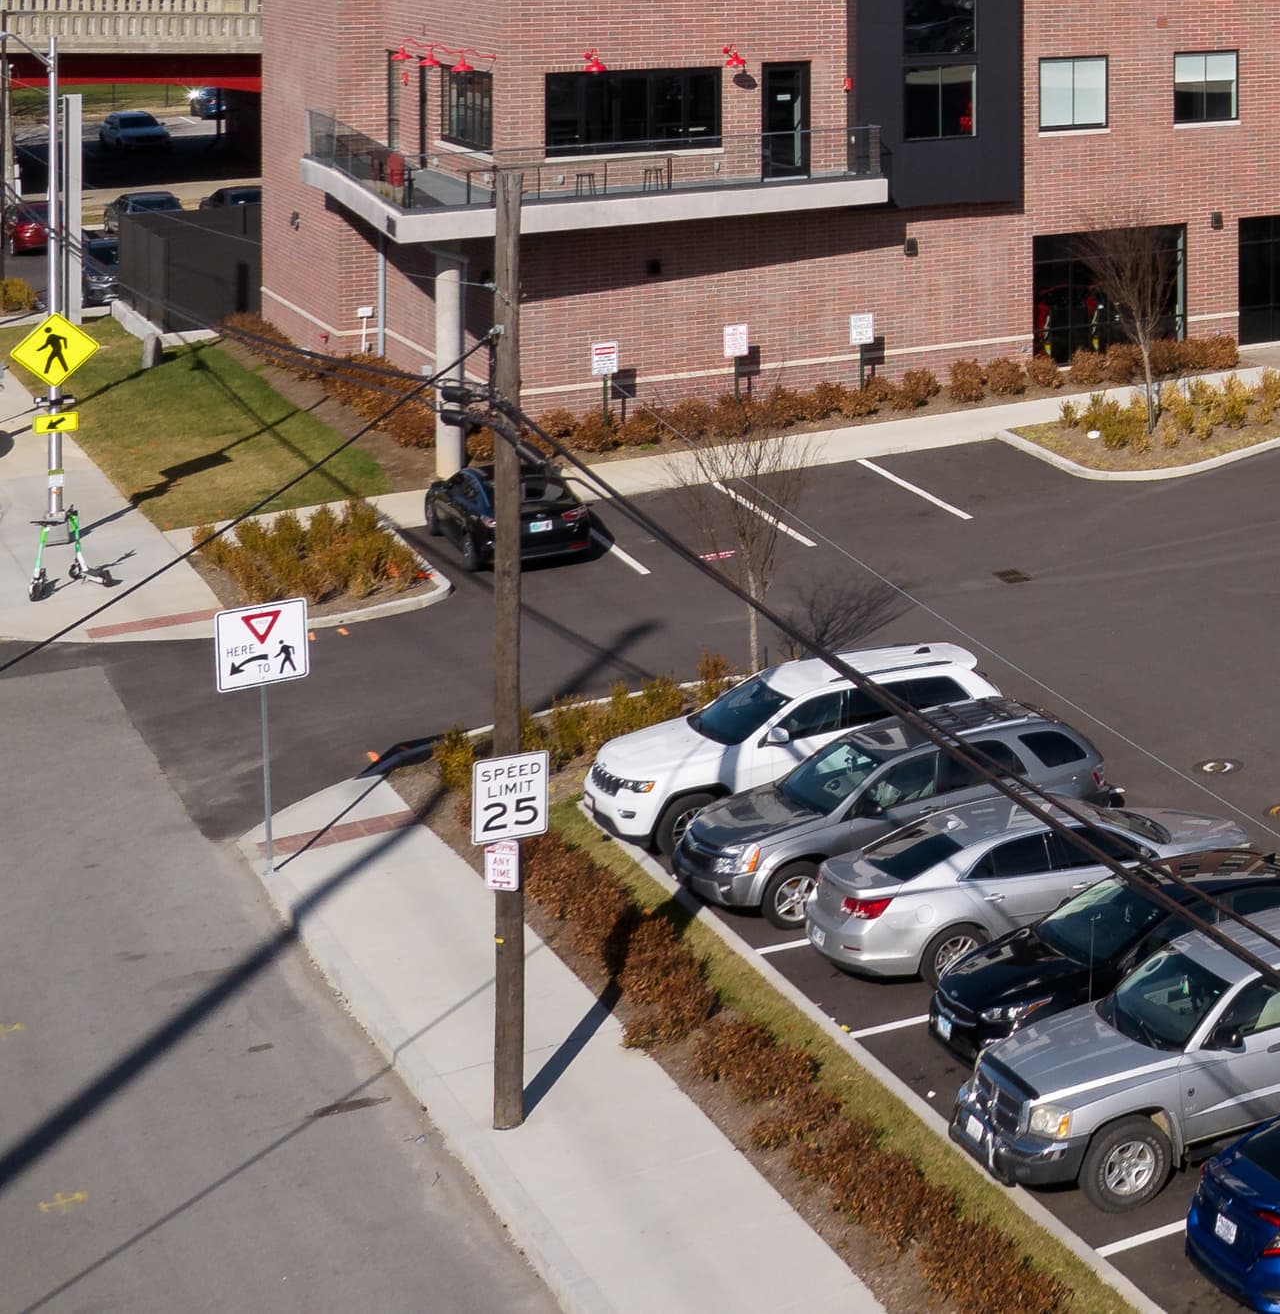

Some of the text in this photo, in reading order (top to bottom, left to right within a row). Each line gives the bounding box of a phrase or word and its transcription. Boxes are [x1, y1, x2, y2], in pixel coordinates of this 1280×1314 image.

[226, 643, 256, 658] HERE
[257, 663, 270, 674] TO
[481, 762, 541, 782] SPEED
[487, 779, 534, 798] LIMIT
[482, 796, 539, 833] 25
[492, 856, 511, 867] ANY
[492, 868, 512, 879] TIME
